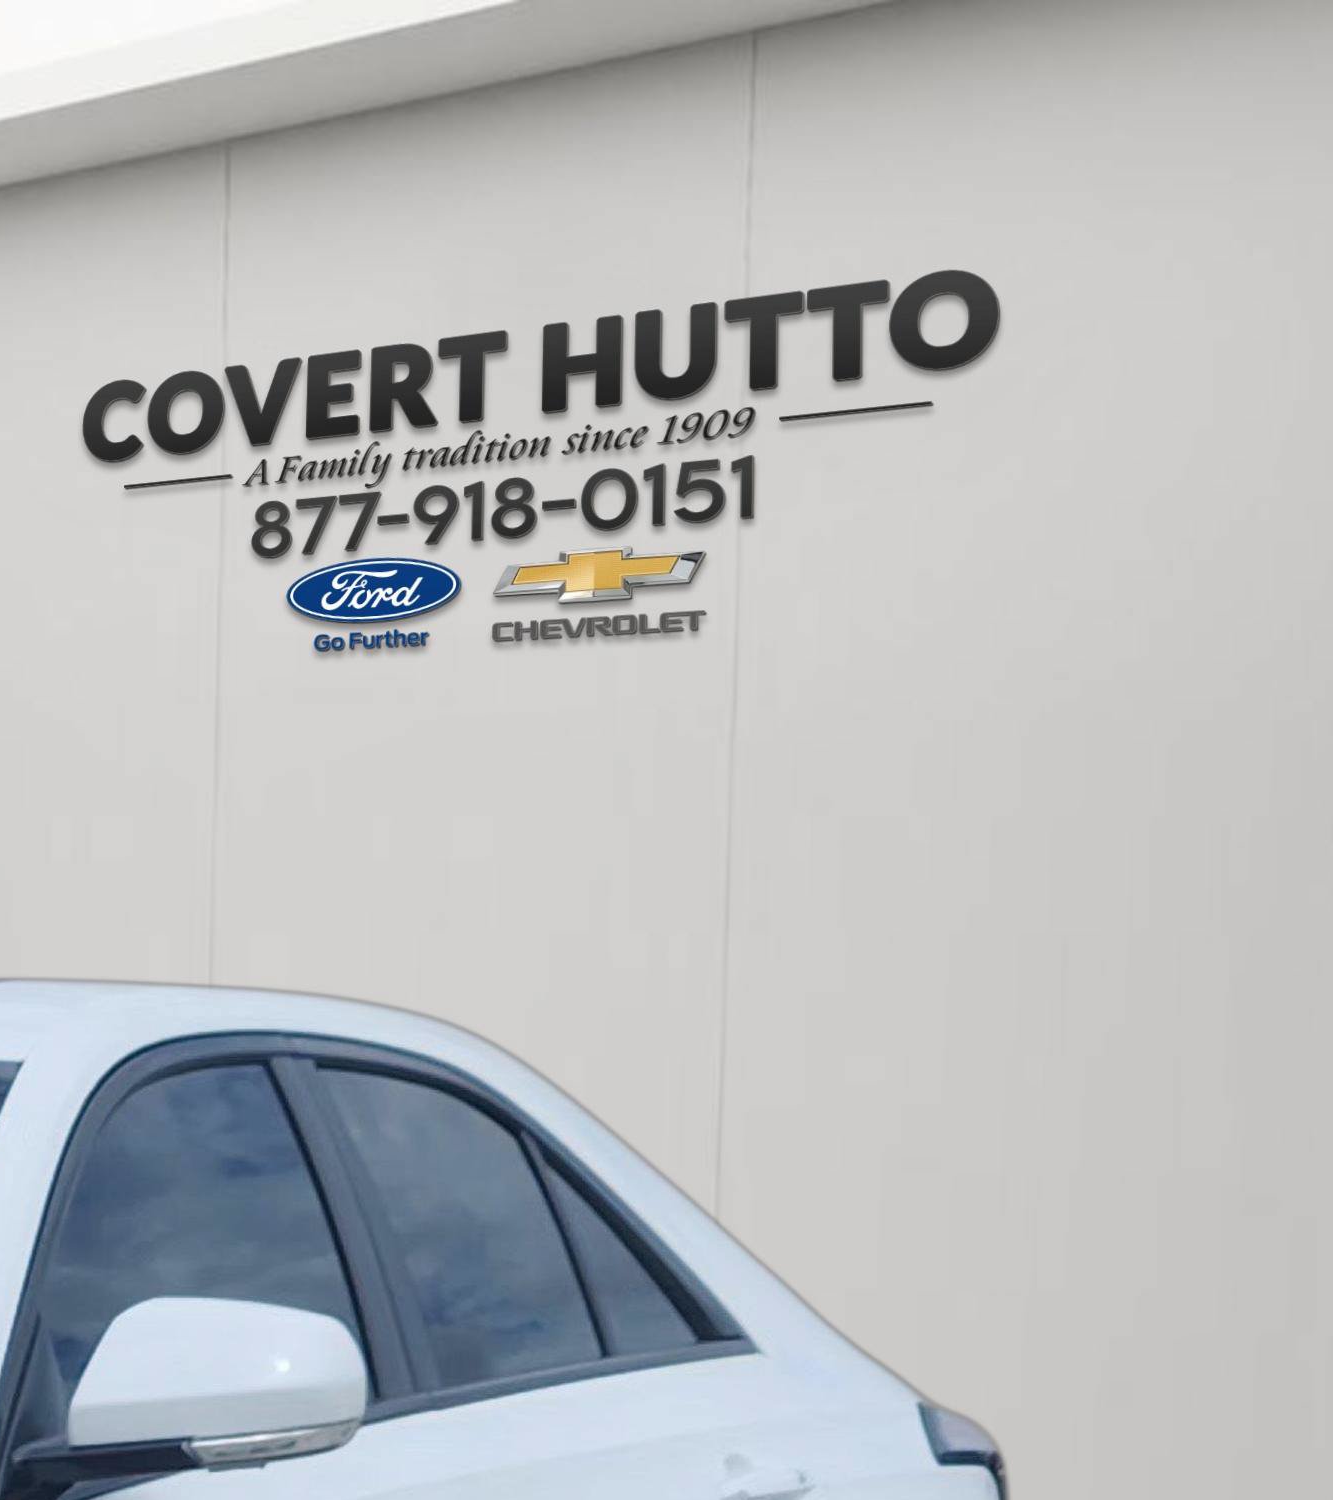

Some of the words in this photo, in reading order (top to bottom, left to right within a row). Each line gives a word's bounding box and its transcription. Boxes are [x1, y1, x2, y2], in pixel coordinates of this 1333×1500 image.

[81, 329, 509, 463] COVERT
[542, 269, 1001, 411] HUTTO
[243, 458, 270, 488] A
[275, 442, 391, 488] Family
[402, 430, 550, 473] tradition
[561, 423, 650, 457] since
[656, 406, 757, 447] 1909
[250, 455, 755, 559] 877-918-0151
[320, 569, 423, 610] Ford
[313, 632, 345, 653] Go
[348, 629, 430, 650] Further
[491, 610, 707, 643] CHEVROLET
